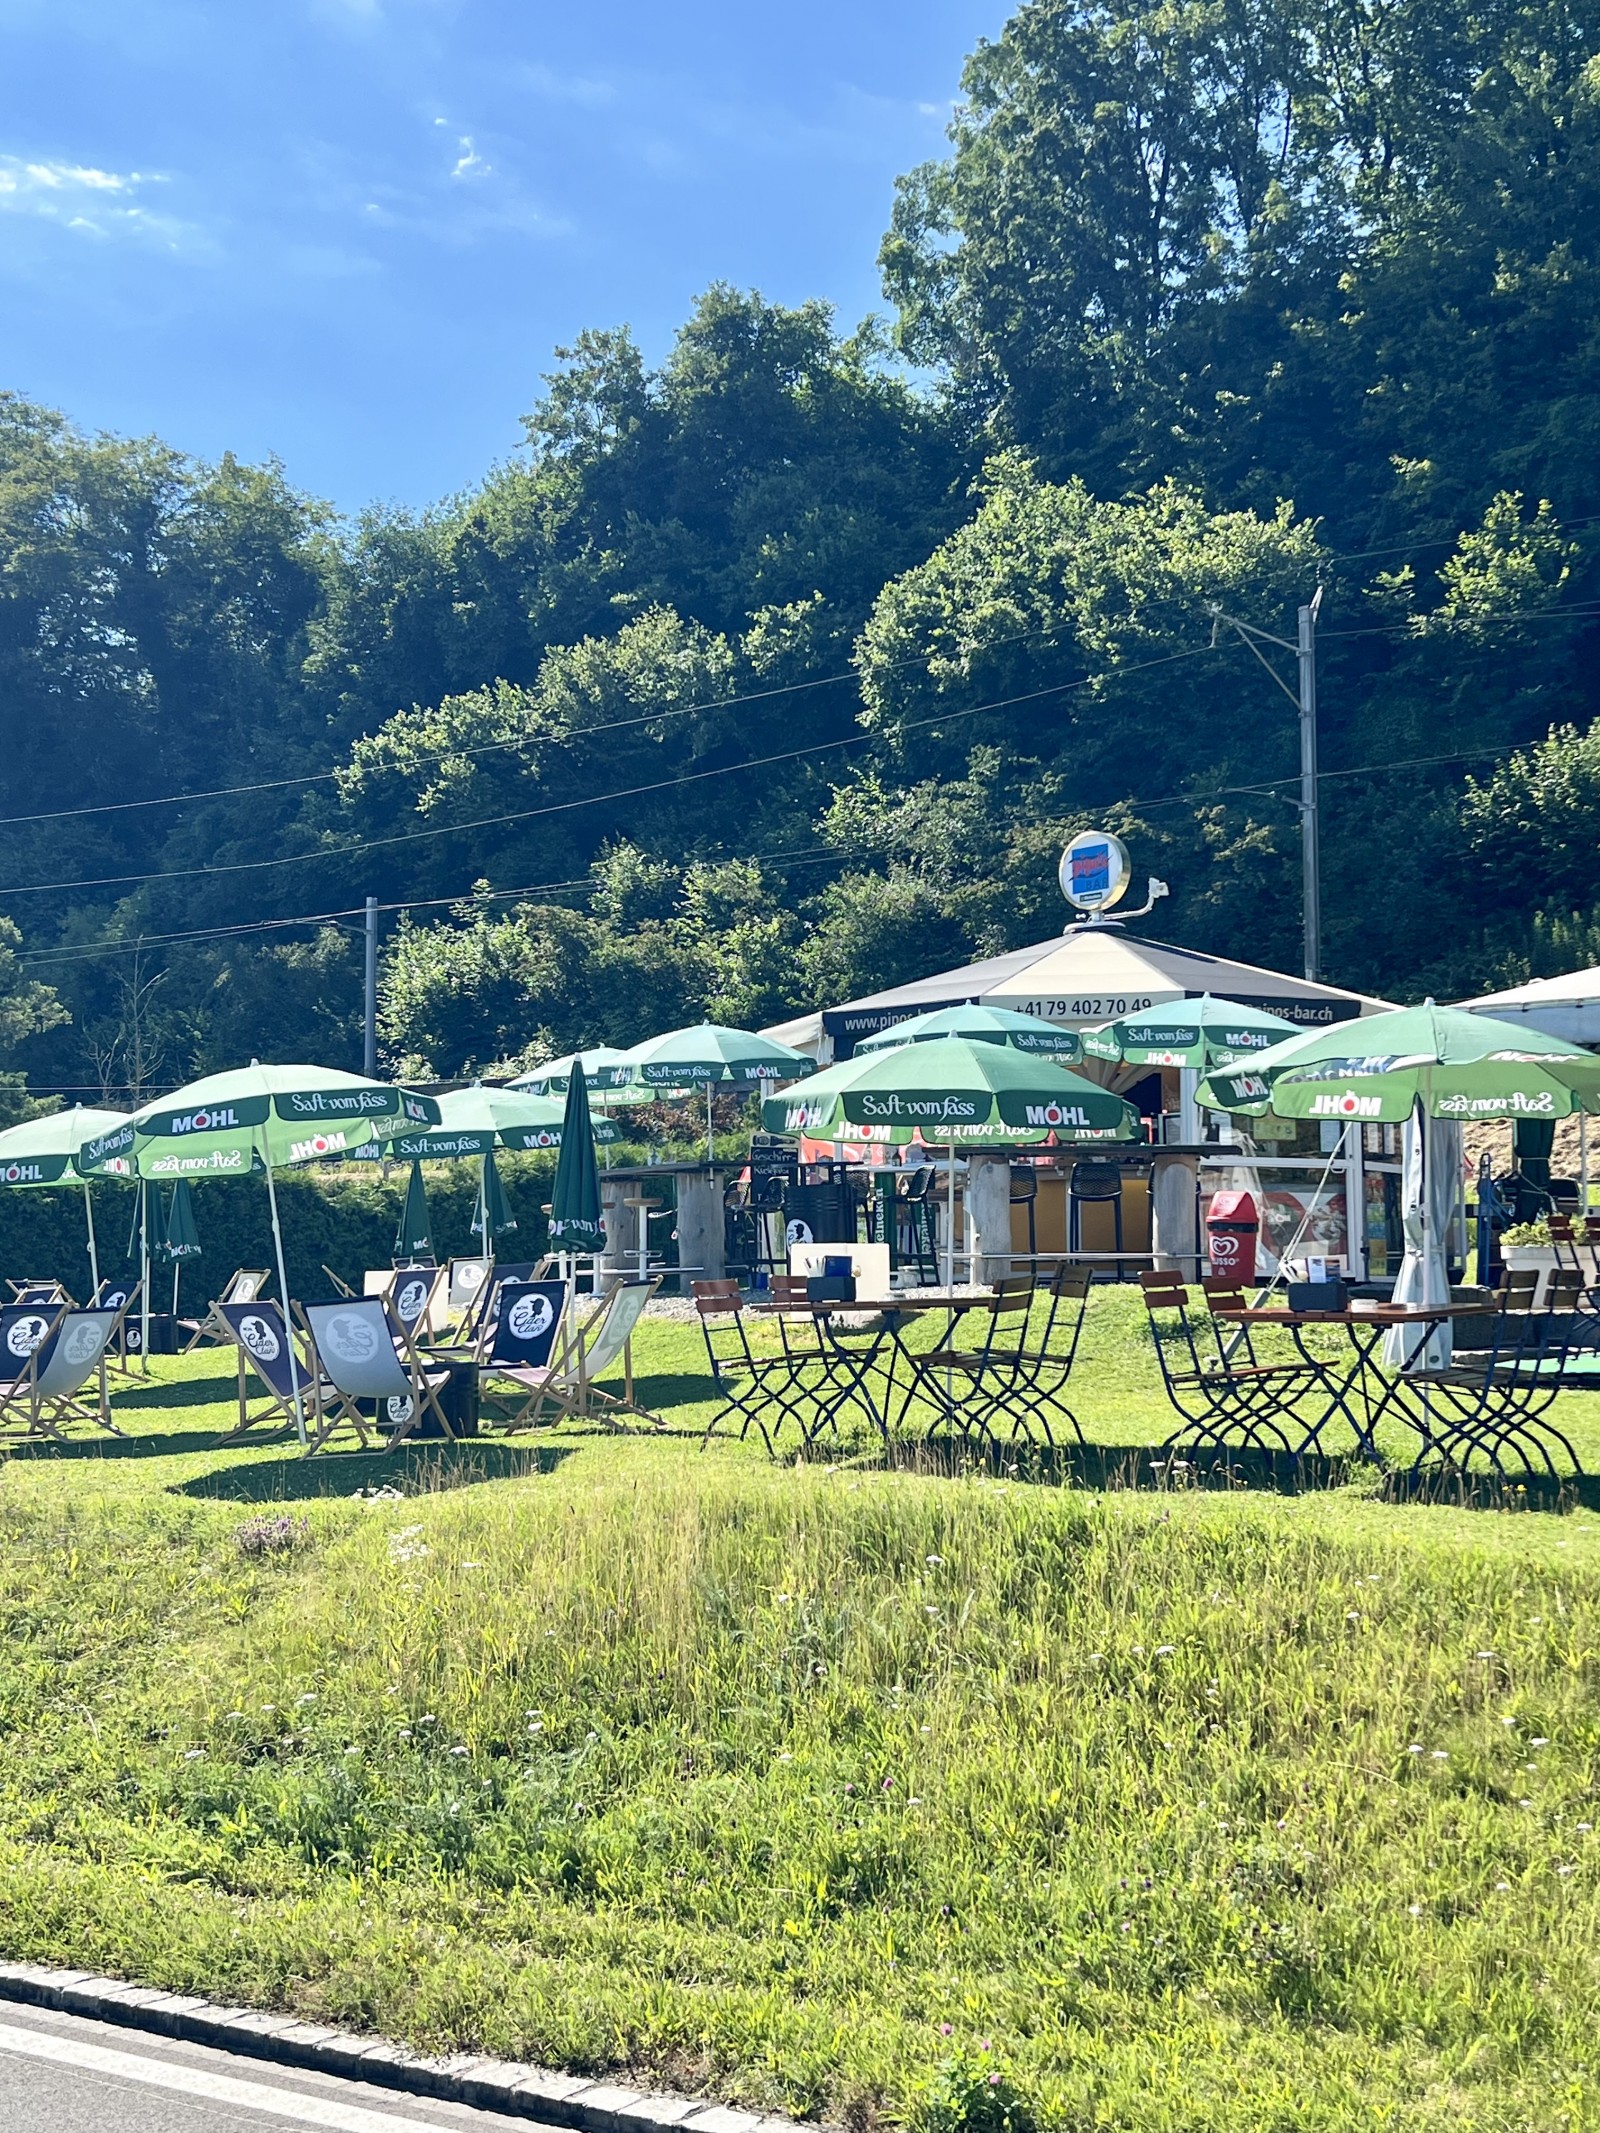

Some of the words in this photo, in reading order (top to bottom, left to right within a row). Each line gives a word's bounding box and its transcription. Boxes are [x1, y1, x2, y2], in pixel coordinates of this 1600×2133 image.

[1047, 1001, 1067, 1016] 79
[1071, 999, 1102, 1015] 402
[1106, 999, 1126, 1014] 70
[1128, 1028, 1155, 1042] Saft
[647, 1065, 671, 1077] Saft
[291, 1093, 328, 1112] Saft
[328, 1098, 358, 1110] vom
[862, 1094, 904, 1116] Saft
[905, 1101, 942, 1115] vom
[400, 1138, 431, 1154] Saft
[523, 1129, 562, 1148] MÖH
